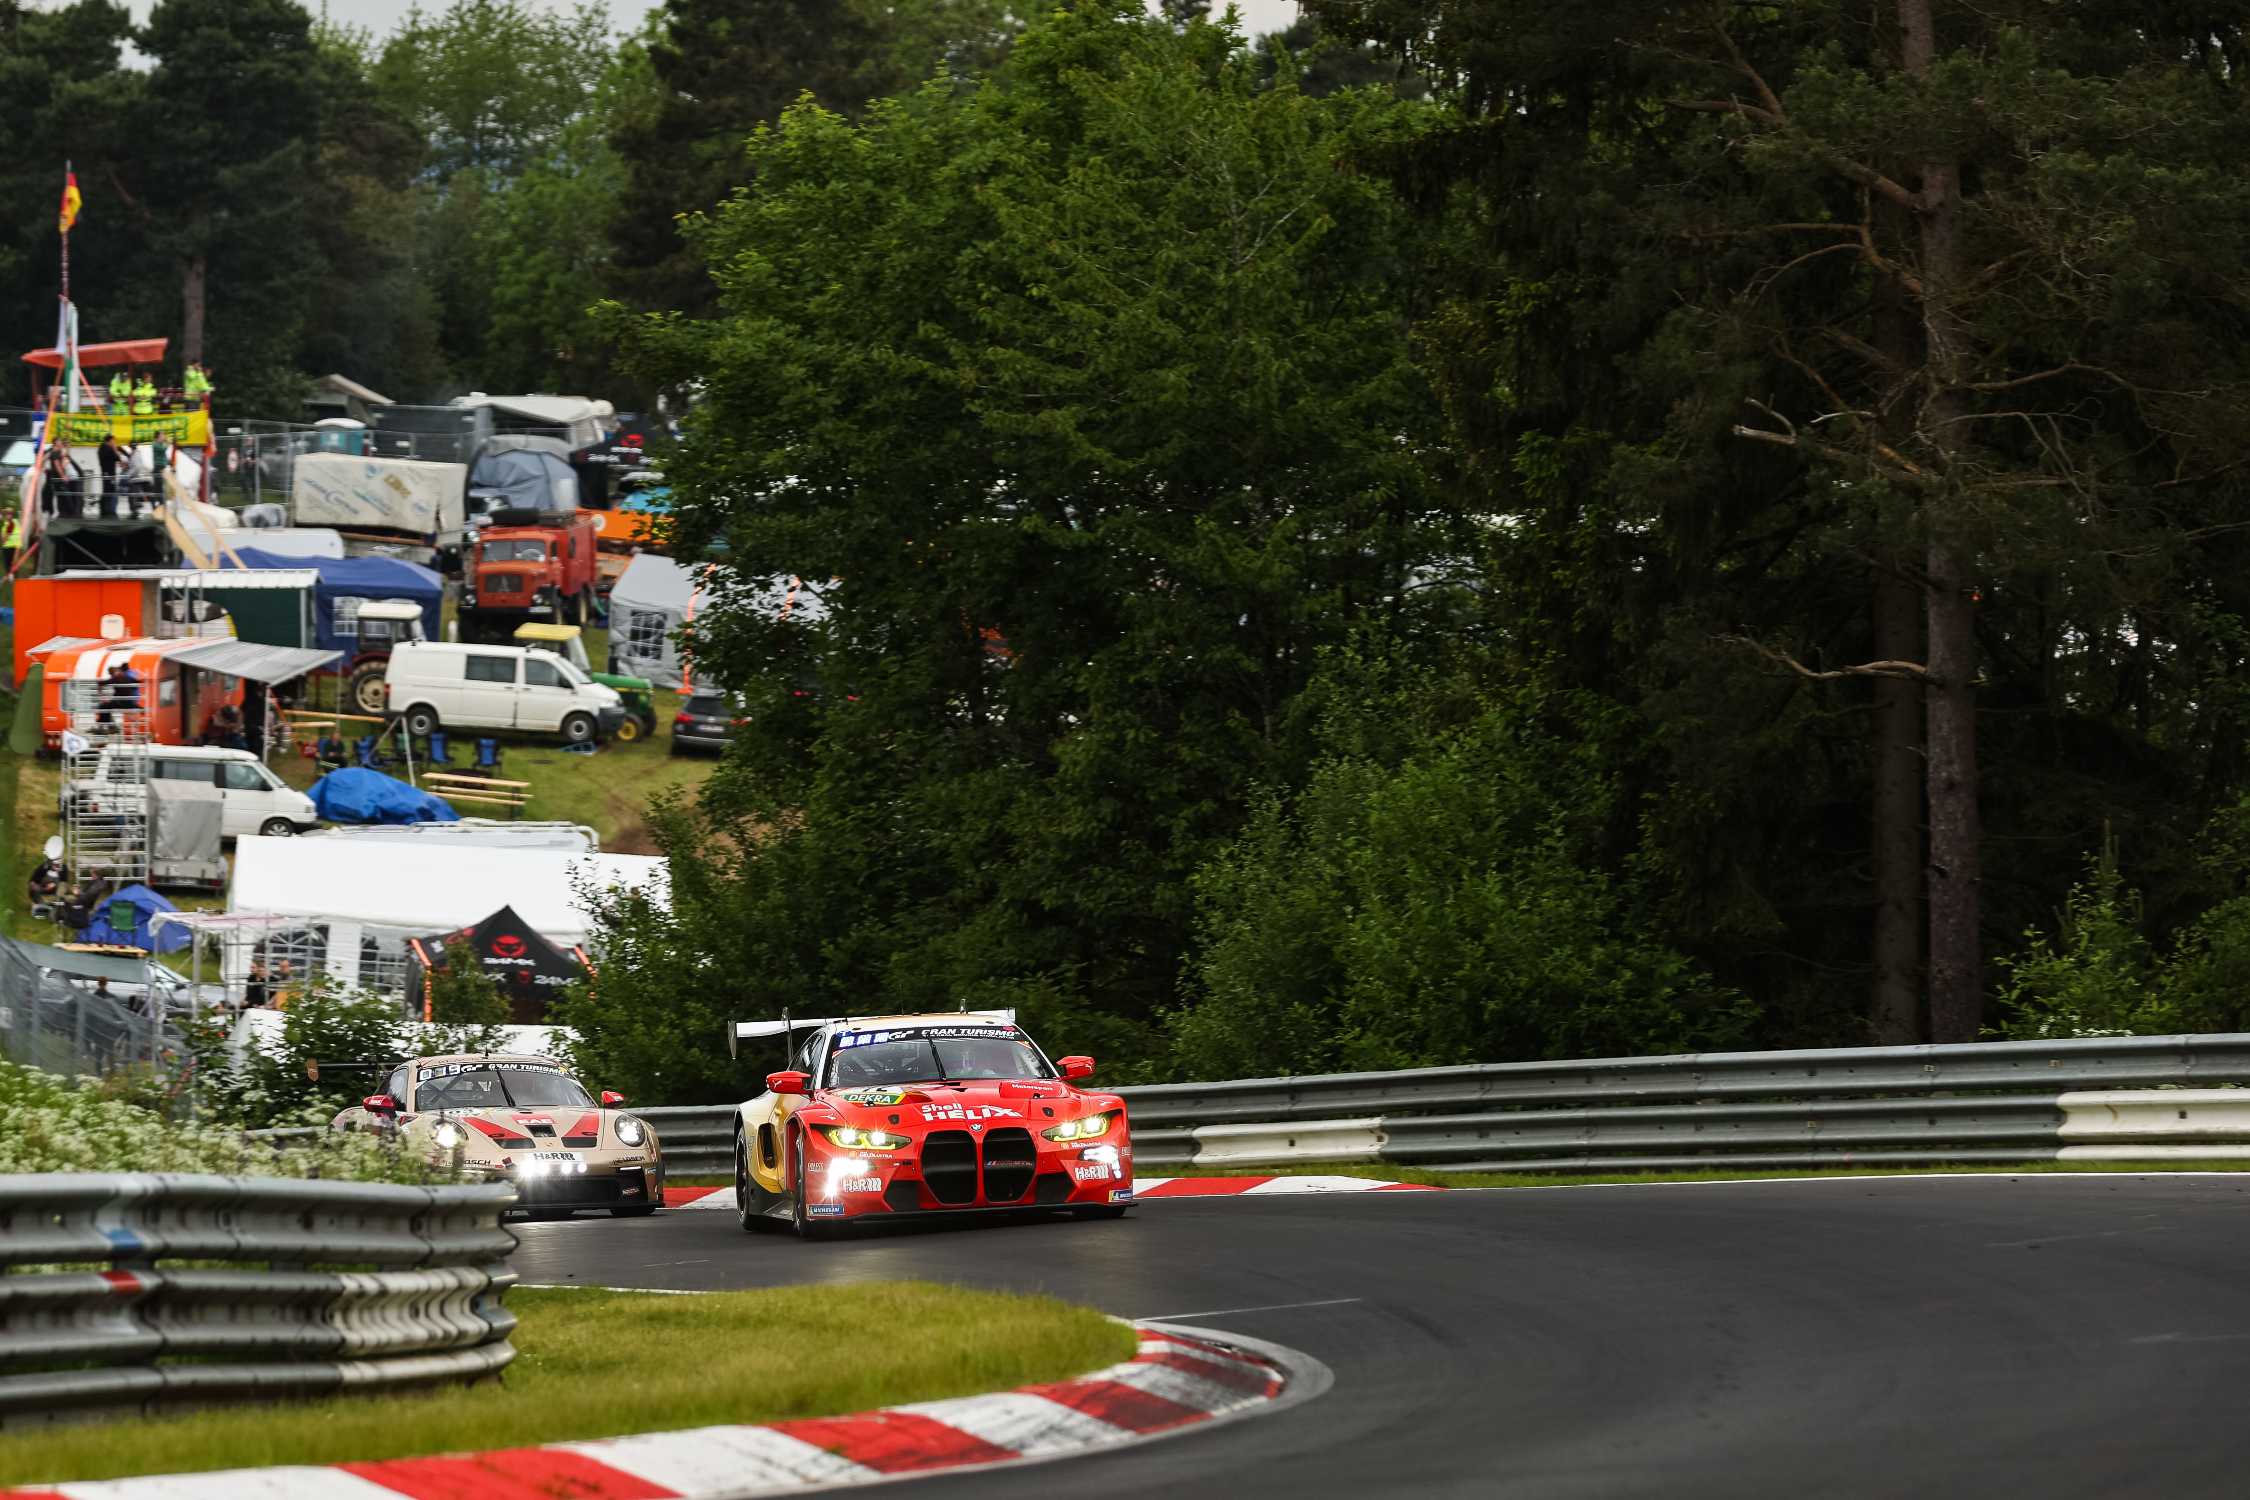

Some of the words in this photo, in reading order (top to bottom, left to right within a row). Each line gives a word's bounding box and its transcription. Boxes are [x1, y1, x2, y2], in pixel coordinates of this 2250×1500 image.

[921, 1028, 955, 1036] GRAN
[957, 1028, 1015, 1037] TURISMO
[848, 1094, 891, 1103] DEKRA
[921, 1103, 963, 1113] Shell
[922, 1104, 1024, 1121] HELIX
